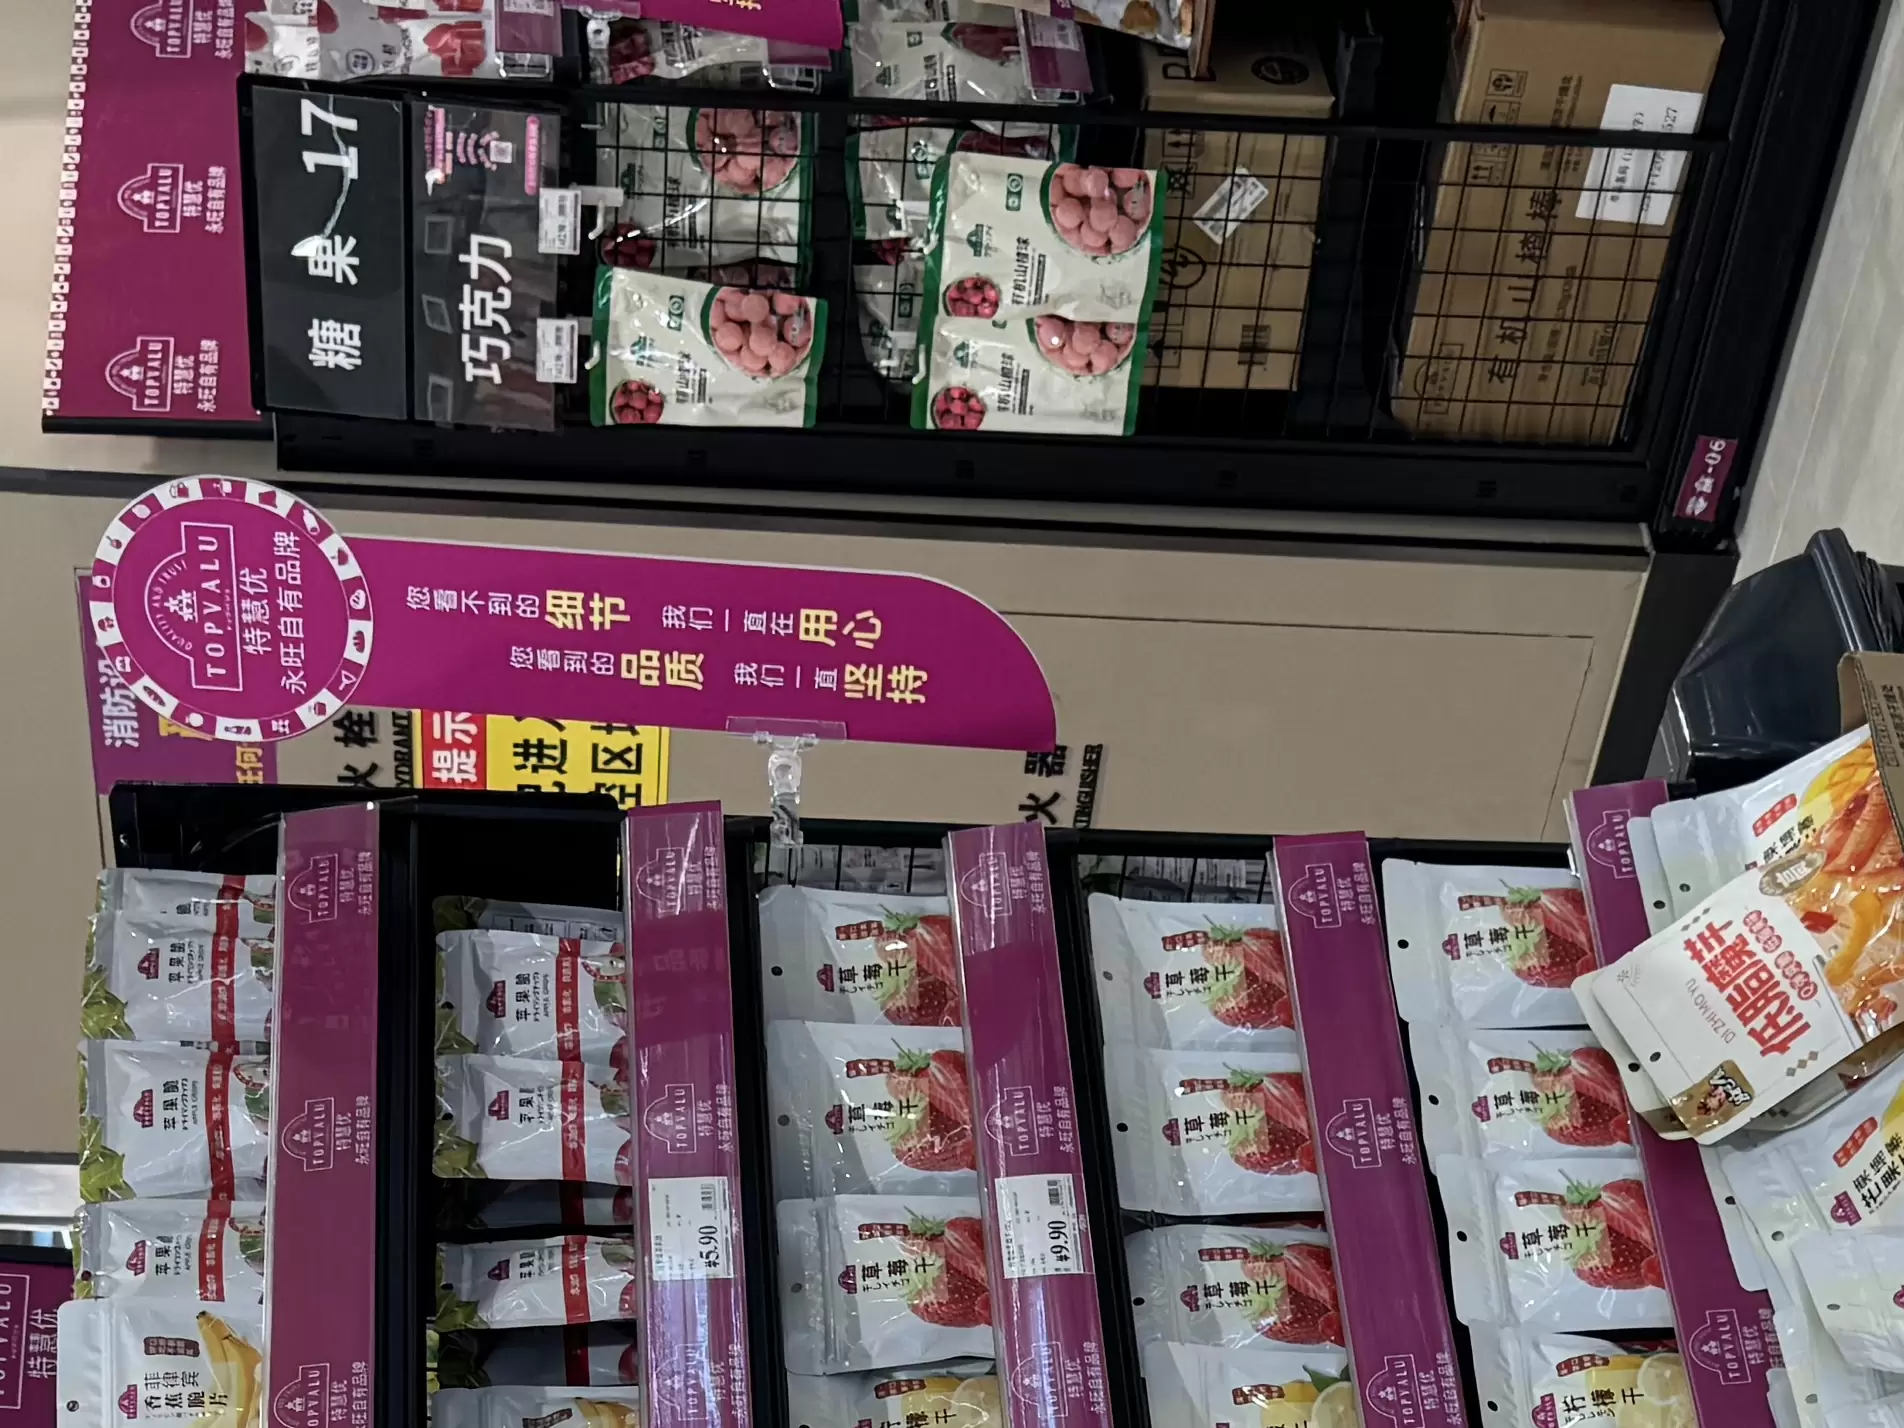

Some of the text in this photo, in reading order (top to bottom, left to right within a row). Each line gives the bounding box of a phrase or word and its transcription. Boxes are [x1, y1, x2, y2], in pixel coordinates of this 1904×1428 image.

[193, 9, 213, 45] 特慧优
[153, 168, 174, 228] TOPVALU
[183, 180, 204, 218] 特慧优
[205, 165, 228, 234] 永旺自有品牌
[299, 97, 363, 371] 糖果 17
[458, 233, 514, 385] 巧克力
[143, 342, 164, 406] TOPVALU
[173, 354, 196, 395] 特慧优
[197, 338, 220, 413] 永旺自有品牌
[150, 558, 194, 651] QUALITY AND TRUST
[197, 535, 228, 678] TOPVALU
[239, 566, 273, 656] 特慧优
[273, 531, 307, 695] 永旺自有品牌
[405, 585, 883, 651] 您看不到的细节 我们一直在用心
[508, 645, 930, 705] 您看到的品质 我们一直坚持
[1311, 866, 1334, 924] TOPVALU
[1462, 921, 1539, 950] 草莓干
[837, 958, 908, 987] 草莓干
[1164, 963, 1235, 989] 草莓干
[1682, 919, 1812, 1058] 低脂魔芋
[1684, 977, 1738, 1045] DI ZHI MO YU
[672, 1086, 689, 1150] TOPVALU
[696, 1099, 713, 1138] 特慧优
[1010, 1088, 1031, 1152] TOPVALU
[1035, 1100, 1054, 1139] 特慧优
[1182, 1109, 1258, 1134] 草莓干
[1493, 1090, 1568, 1110] 草莓干
[308, 1102, 328, 1166] TOPVALU
[335, 1111, 353, 1152] 特慧优
[1350, 1102, 1374, 1165] TOPVALU
[1519, 1221, 1599, 1249] 草莓干
[860, 1255, 936, 1282] 草莓干
[1203, 1279, 1278, 1301] 草莓干
[27, 1307, 59, 1380] 特慧优
[1714, 1313, 1740, 1379] TOPVALU
[143, 1370, 201, 1391] 菲律宾
[143, 1390, 230, 1413] 香蕉脆片
[328, 1379, 351, 1422] 特慧优
[1391, 1359, 1415, 1426] TOPVALU
[1563, 1385, 1646, 1415] 柠檬干
